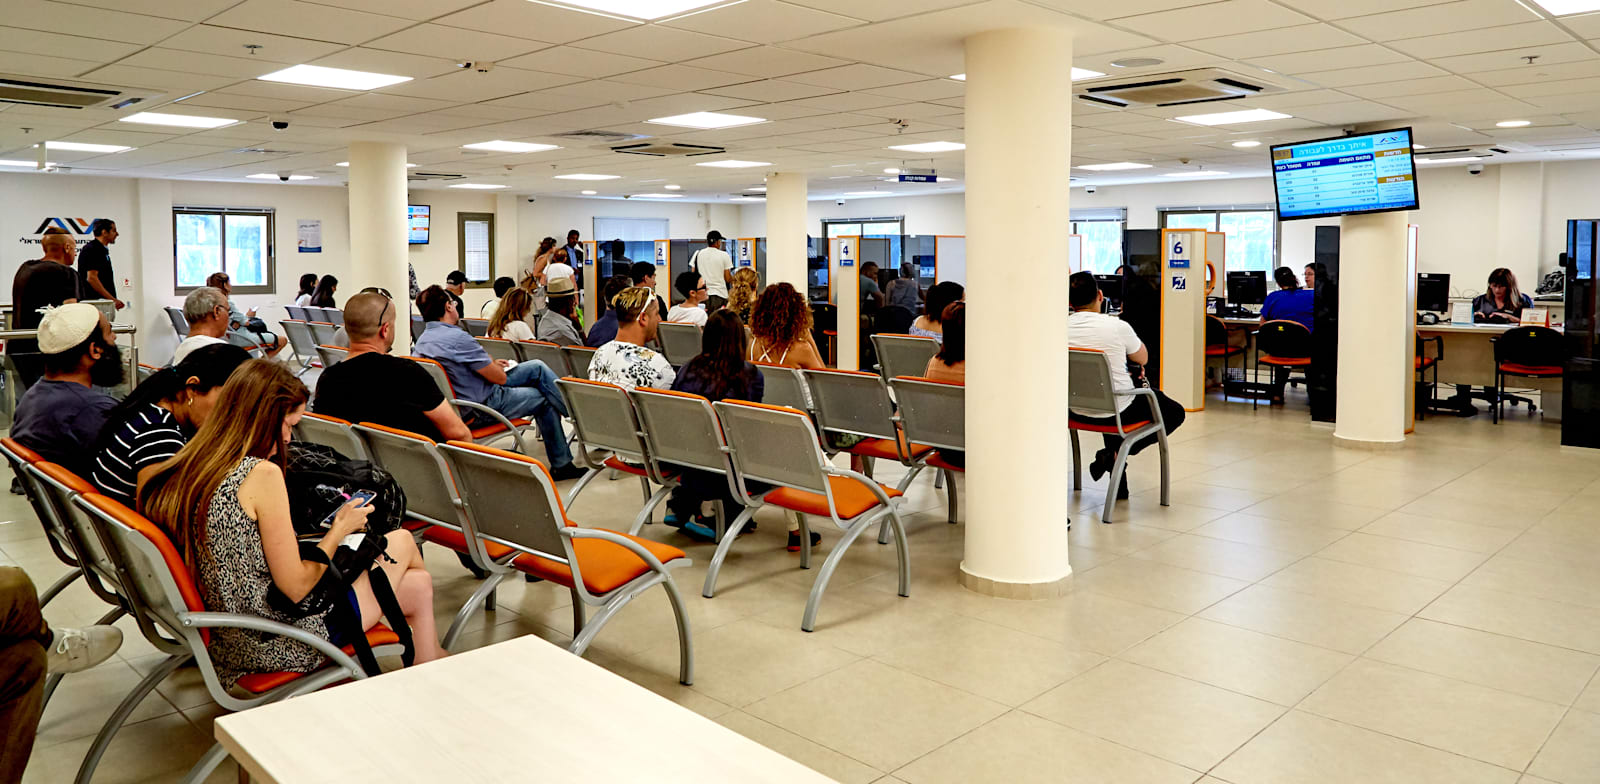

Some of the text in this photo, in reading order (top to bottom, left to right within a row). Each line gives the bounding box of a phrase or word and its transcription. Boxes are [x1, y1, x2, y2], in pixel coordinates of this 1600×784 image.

[1327, 144, 1346, 153] בדרך
[1348, 141, 1367, 150] איתך
[1299, 146, 1325, 156] לעבודה
[658, 248, 663, 256] 2
[742, 247, 748, 256] 3
[842, 245, 849, 256] 4
[1174, 241, 1183, 254] 6
